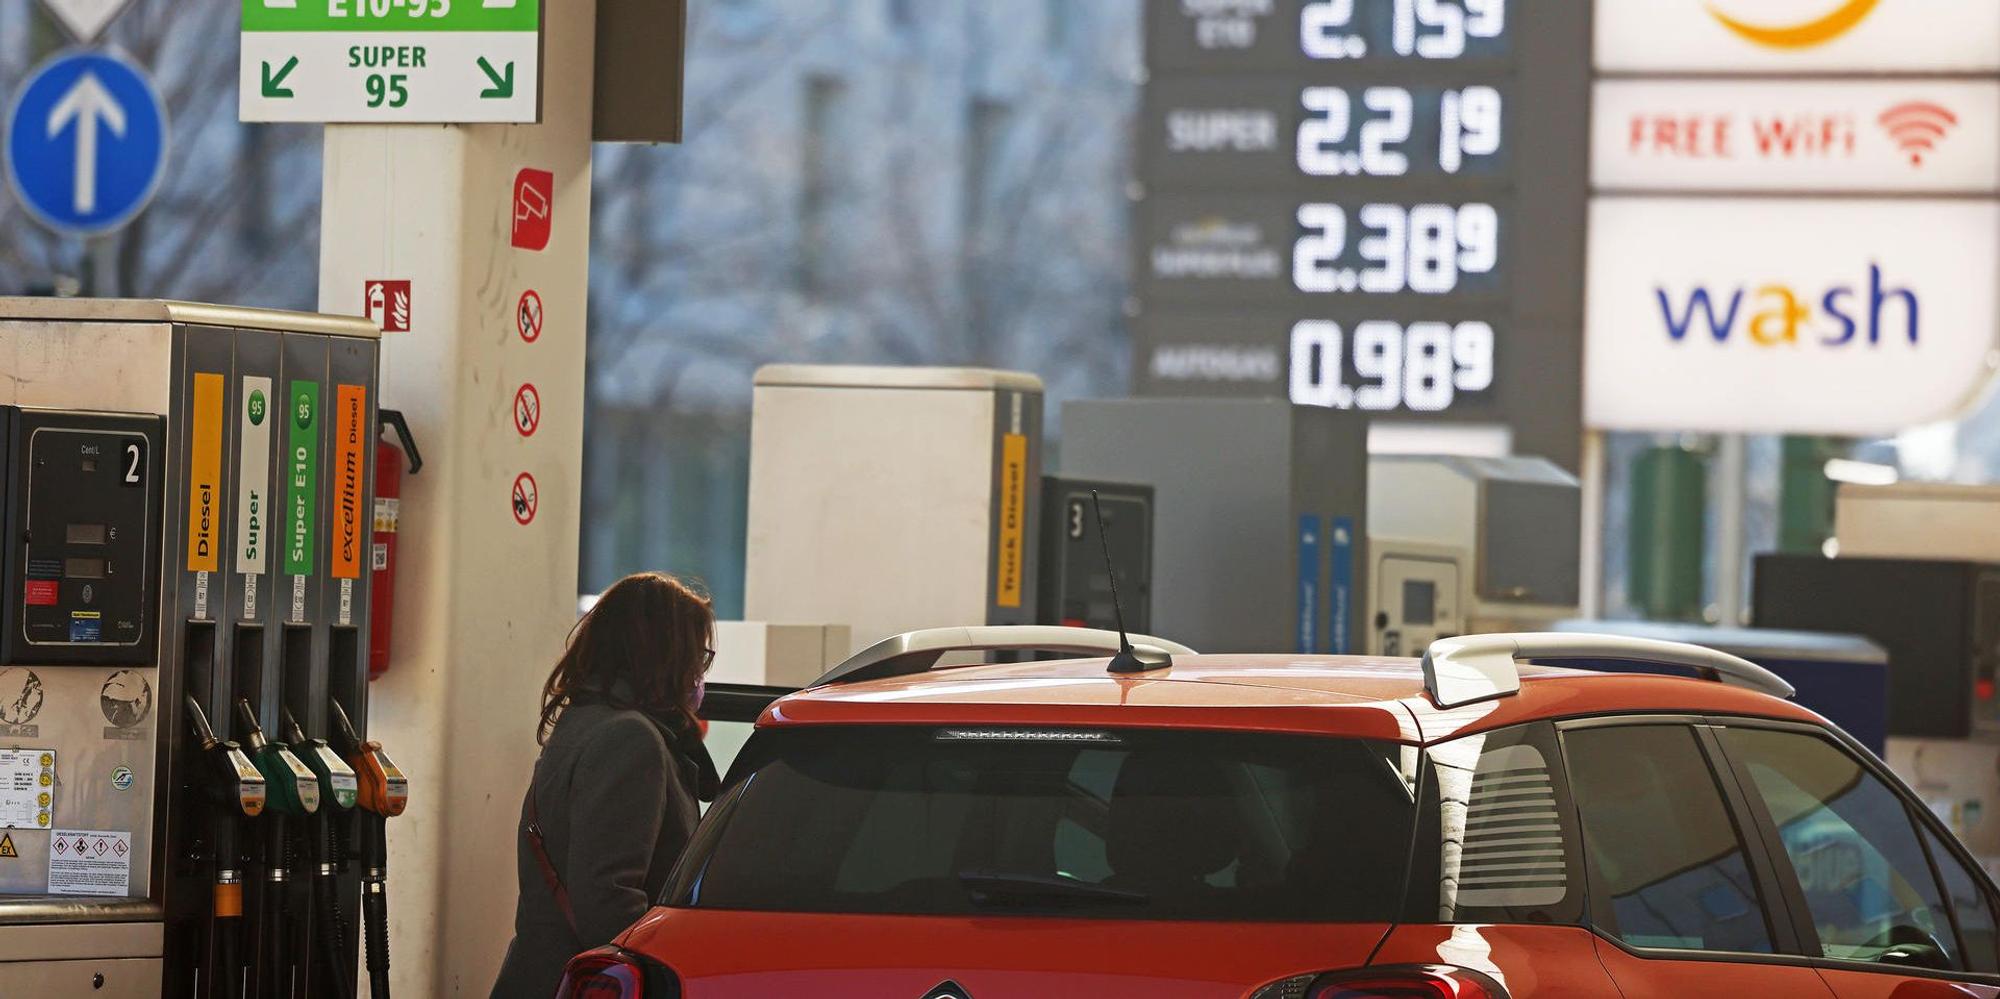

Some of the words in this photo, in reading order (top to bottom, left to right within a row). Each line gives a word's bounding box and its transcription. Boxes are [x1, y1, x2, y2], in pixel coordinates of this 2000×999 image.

[349, 46, 426, 67] SUPER
[366, 74, 408, 108] 95
[1628, 114, 1732, 156] FREE
[1293, 203, 1498, 293] 2.389
[1655, 261, 1919, 346] wash
[1290, 319, 1494, 411] 0.989
[252, 401, 262, 415] 95
[299, 404, 309, 419] 95
[126, 444, 139, 482] 2
[296, 447, 307, 487] E10
[343, 452, 356, 562] excellium
[350, 398, 358, 444] Diesel
[198, 484, 210, 557] Diesel
[1008, 463, 1018, 529] Diesel
[1071, 503, 1082, 537] 3
[246, 489, 260, 560] Super
[293, 495, 307, 562] Super
[1005, 538, 1014, 591] Truck
